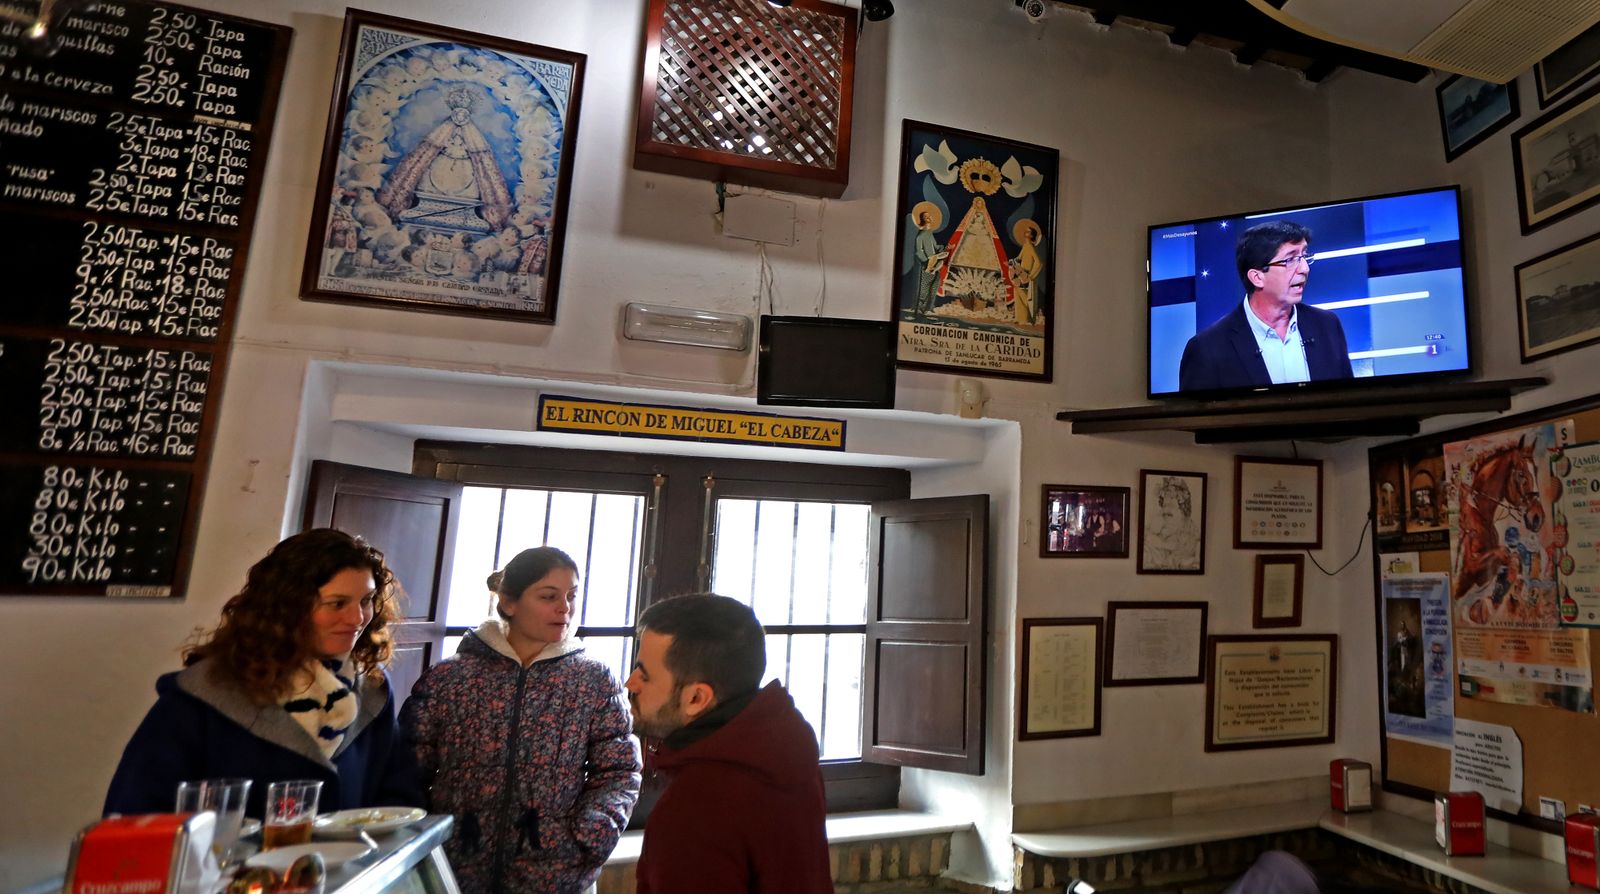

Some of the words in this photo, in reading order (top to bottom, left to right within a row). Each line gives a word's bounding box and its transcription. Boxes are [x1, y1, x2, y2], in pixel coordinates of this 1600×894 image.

[67, 16, 130, 37] marisco
[203, 36, 242, 59] Tapa
[208, 19, 245, 41] Tapa
[199, 54, 250, 79] Ración
[45, 72, 113, 94] Cerveza
[193, 92, 236, 114] Tapa
[197, 73, 237, 98] Tapa
[21, 103, 98, 125] mariscos
[147, 116, 183, 140] Tapa
[144, 136, 179, 159] Tapa
[139, 155, 177, 179] Tapa
[135, 175, 172, 199] Tapa
[4, 183, 76, 204] mariscos
[131, 194, 168, 216] Tapa
[913, 325, 968, 340] CORONACION
[973, 332, 1015, 345] CANONICA
[1020, 337, 1030, 347] DE
[955, 343, 966, 351] DE
[970, 344, 981, 352] LA
[985, 342, 1041, 359] CARIDAD
[1431, 344, 1438, 355] 1
[545, 406, 569, 422] EL
[644, 412, 667, 429] DE
[671, 415, 737, 435] MIGUEL
[89, 467, 129, 490] Kilo
[84, 490, 125, 511] Kilo
[78, 513, 119, 536] Kilo
[75, 536, 116, 558] Kilo
[71, 558, 112, 581] Kilo
